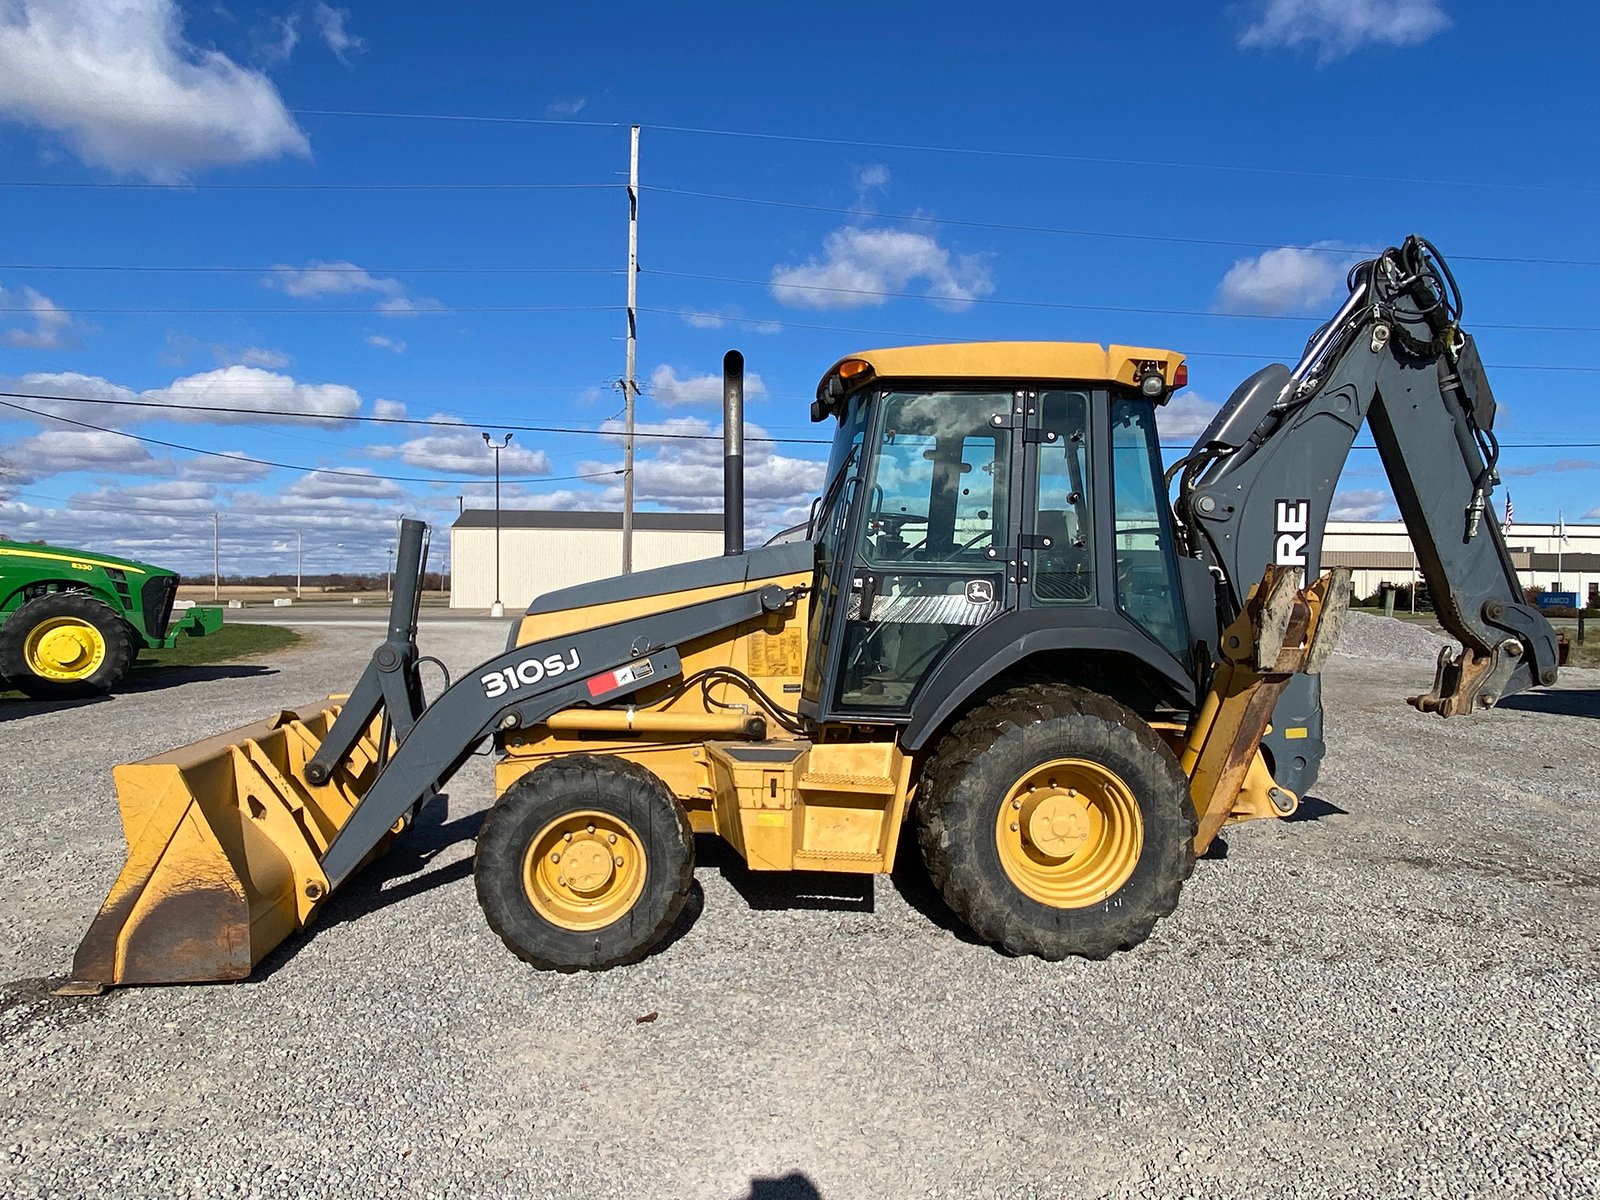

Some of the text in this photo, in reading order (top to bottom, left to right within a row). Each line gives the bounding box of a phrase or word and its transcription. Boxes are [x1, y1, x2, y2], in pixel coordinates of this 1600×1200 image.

[71, 562, 93, 571] 8330
[1276, 501, 1310, 589] RE
[480, 648, 580, 698] 310SJ
